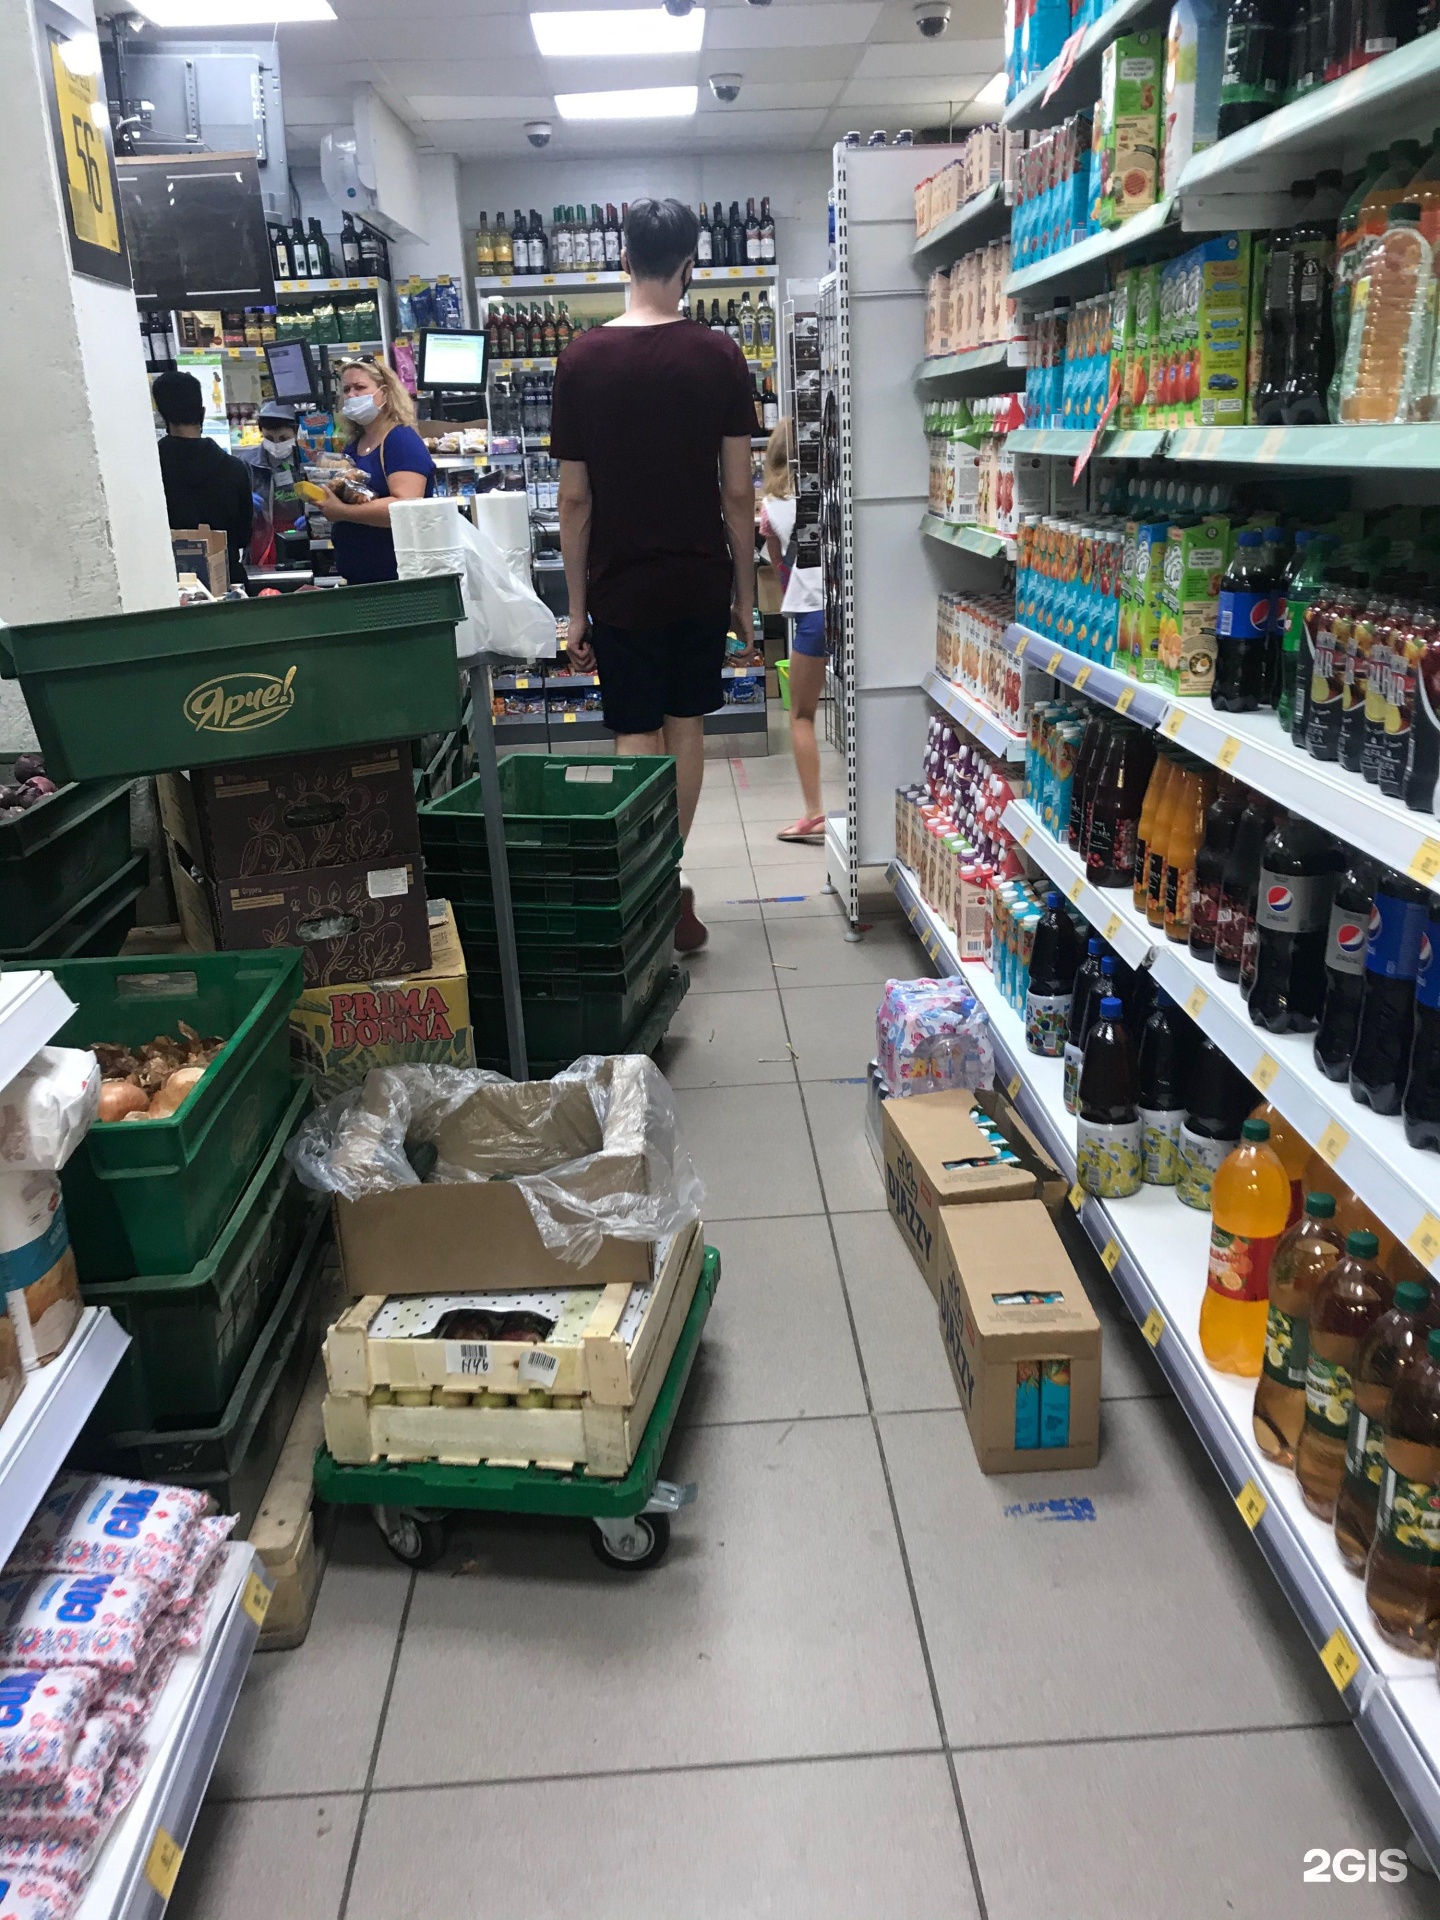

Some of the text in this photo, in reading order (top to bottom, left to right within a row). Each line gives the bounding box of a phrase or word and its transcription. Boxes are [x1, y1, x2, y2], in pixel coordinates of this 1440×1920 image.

[72, 113, 103, 213] 56
[190, 665, 298, 732] Ярче!
[329, 986, 450, 1022] PRIMA
[330, 1013, 455, 1049] DONNA
